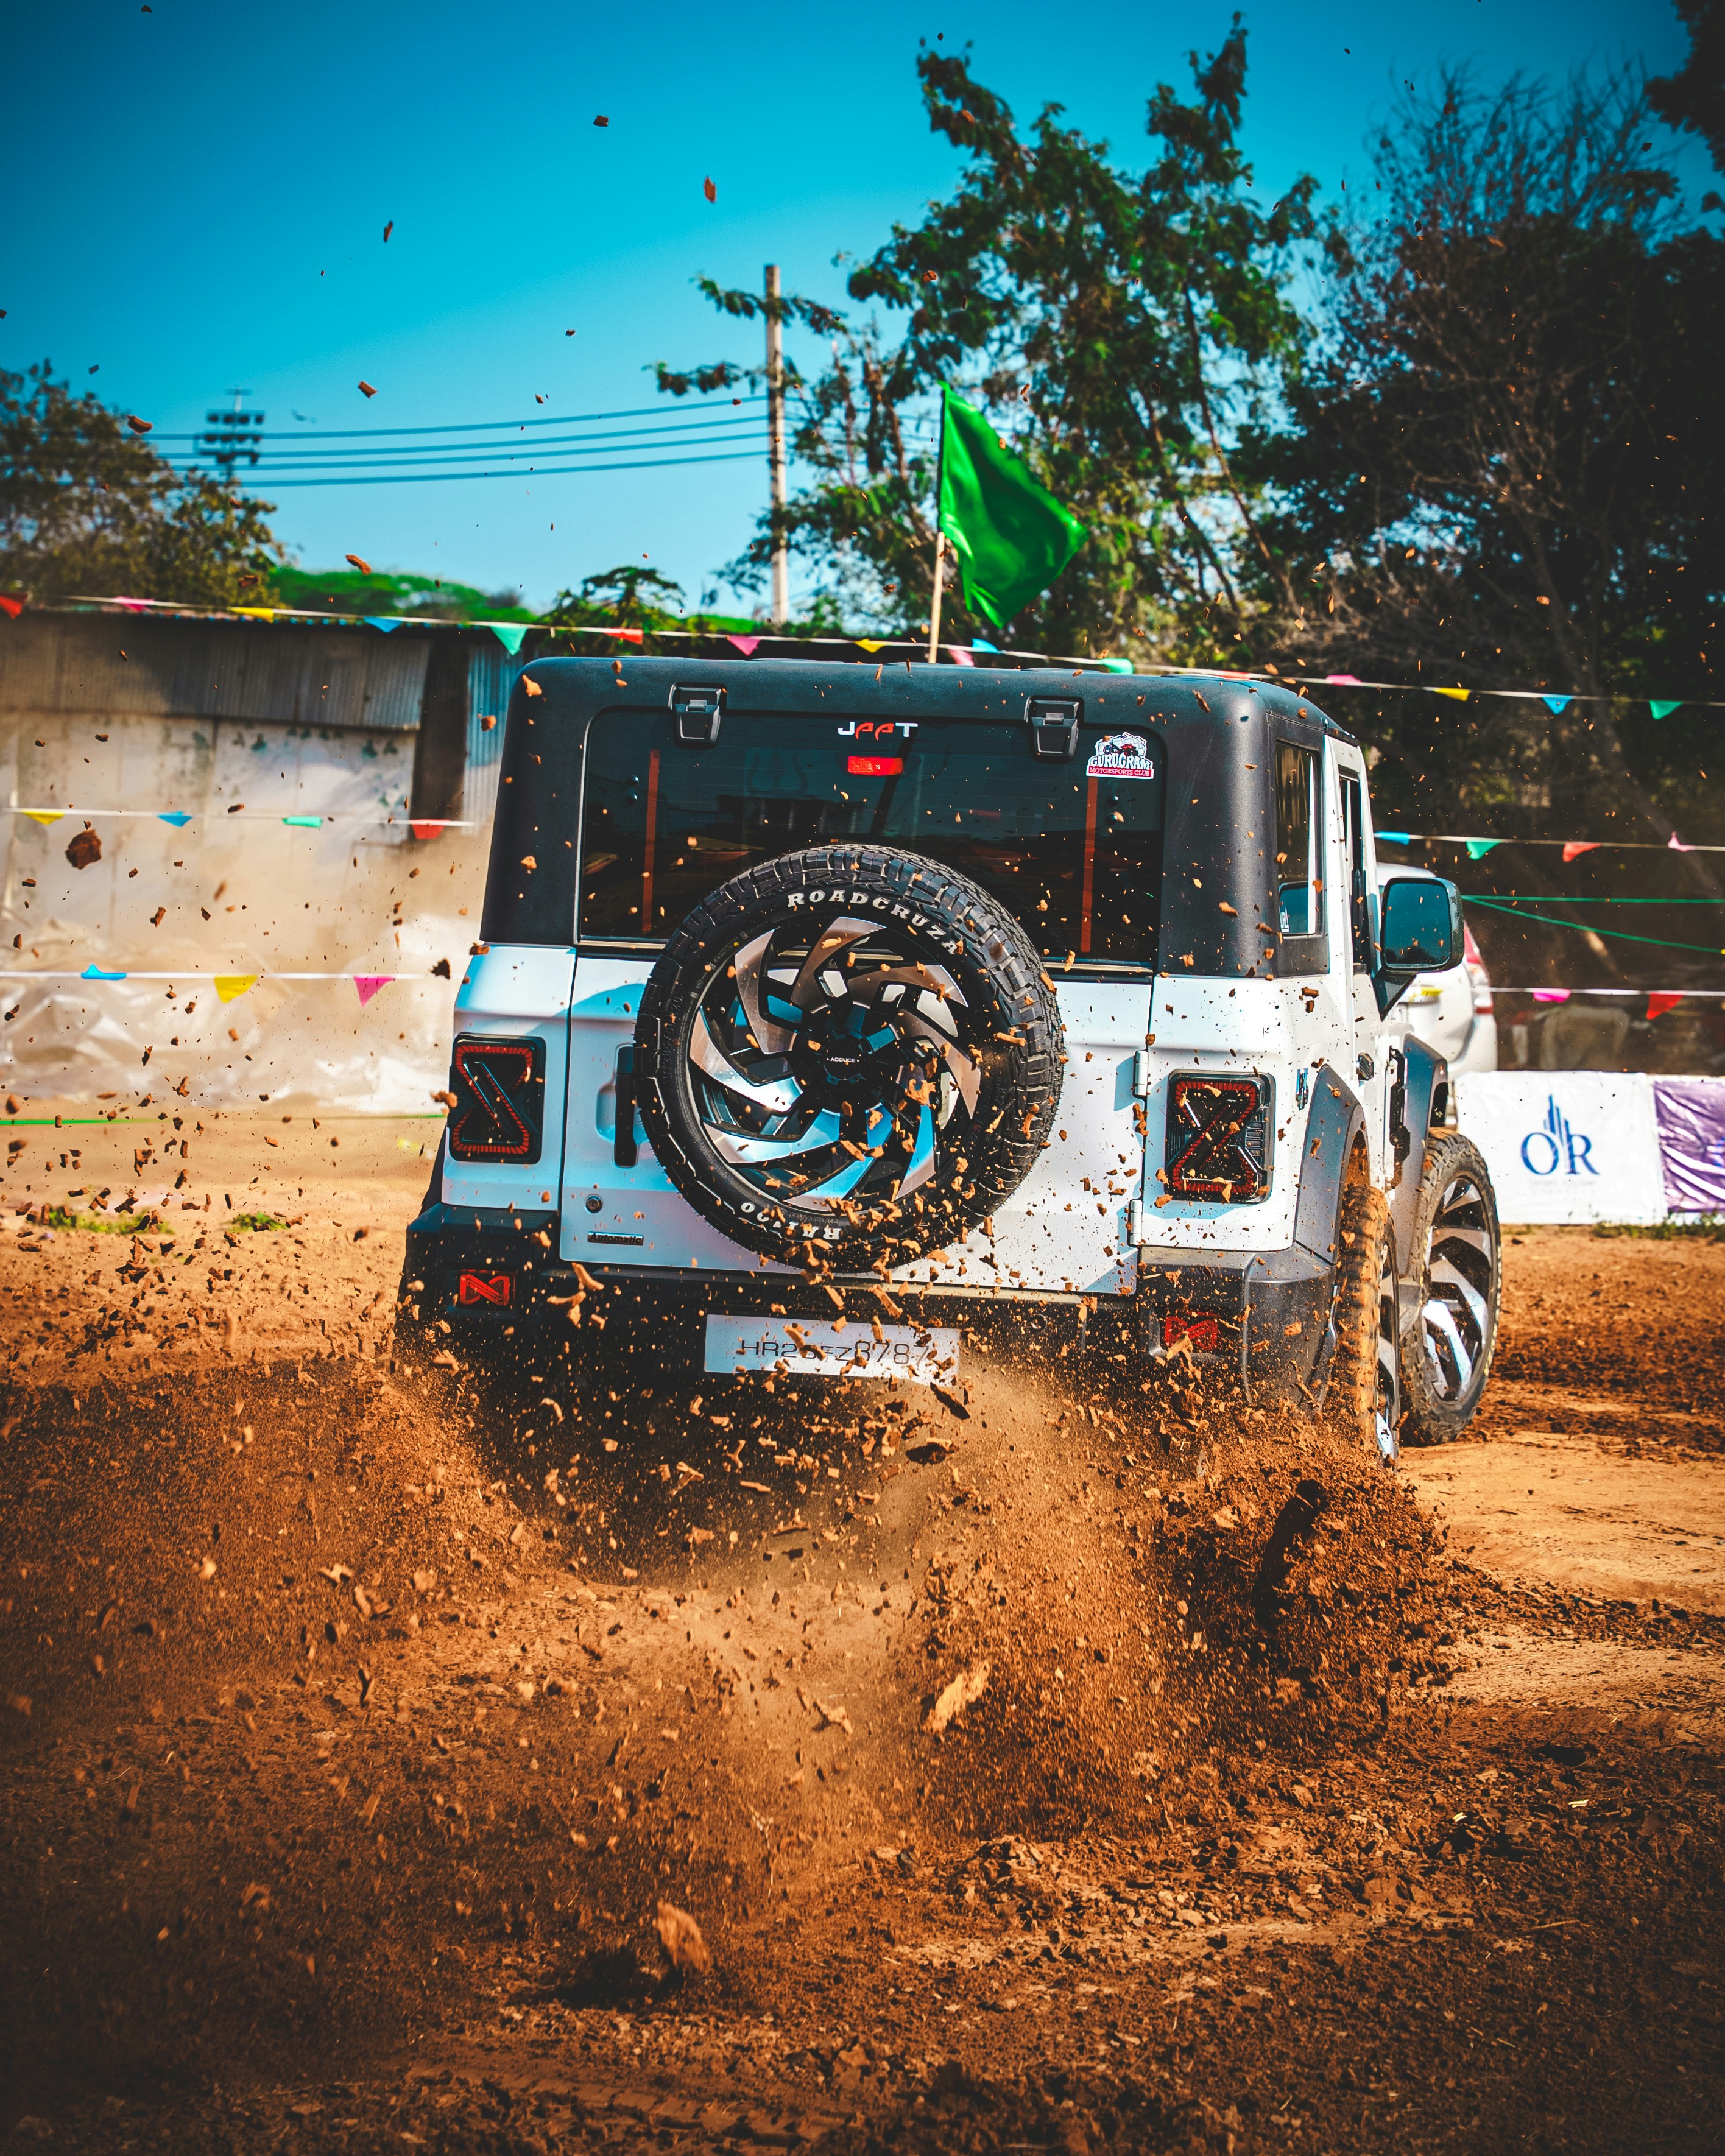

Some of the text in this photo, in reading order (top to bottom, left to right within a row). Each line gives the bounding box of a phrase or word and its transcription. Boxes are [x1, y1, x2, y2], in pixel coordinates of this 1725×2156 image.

[1090, 753, 1151, 770] GURUGRAM
[1089, 767, 1133, 775] MOTORSPORTS
[788, 889, 958, 955] ROADCRUZA
[589, 1233, 642, 1244] Automatic
